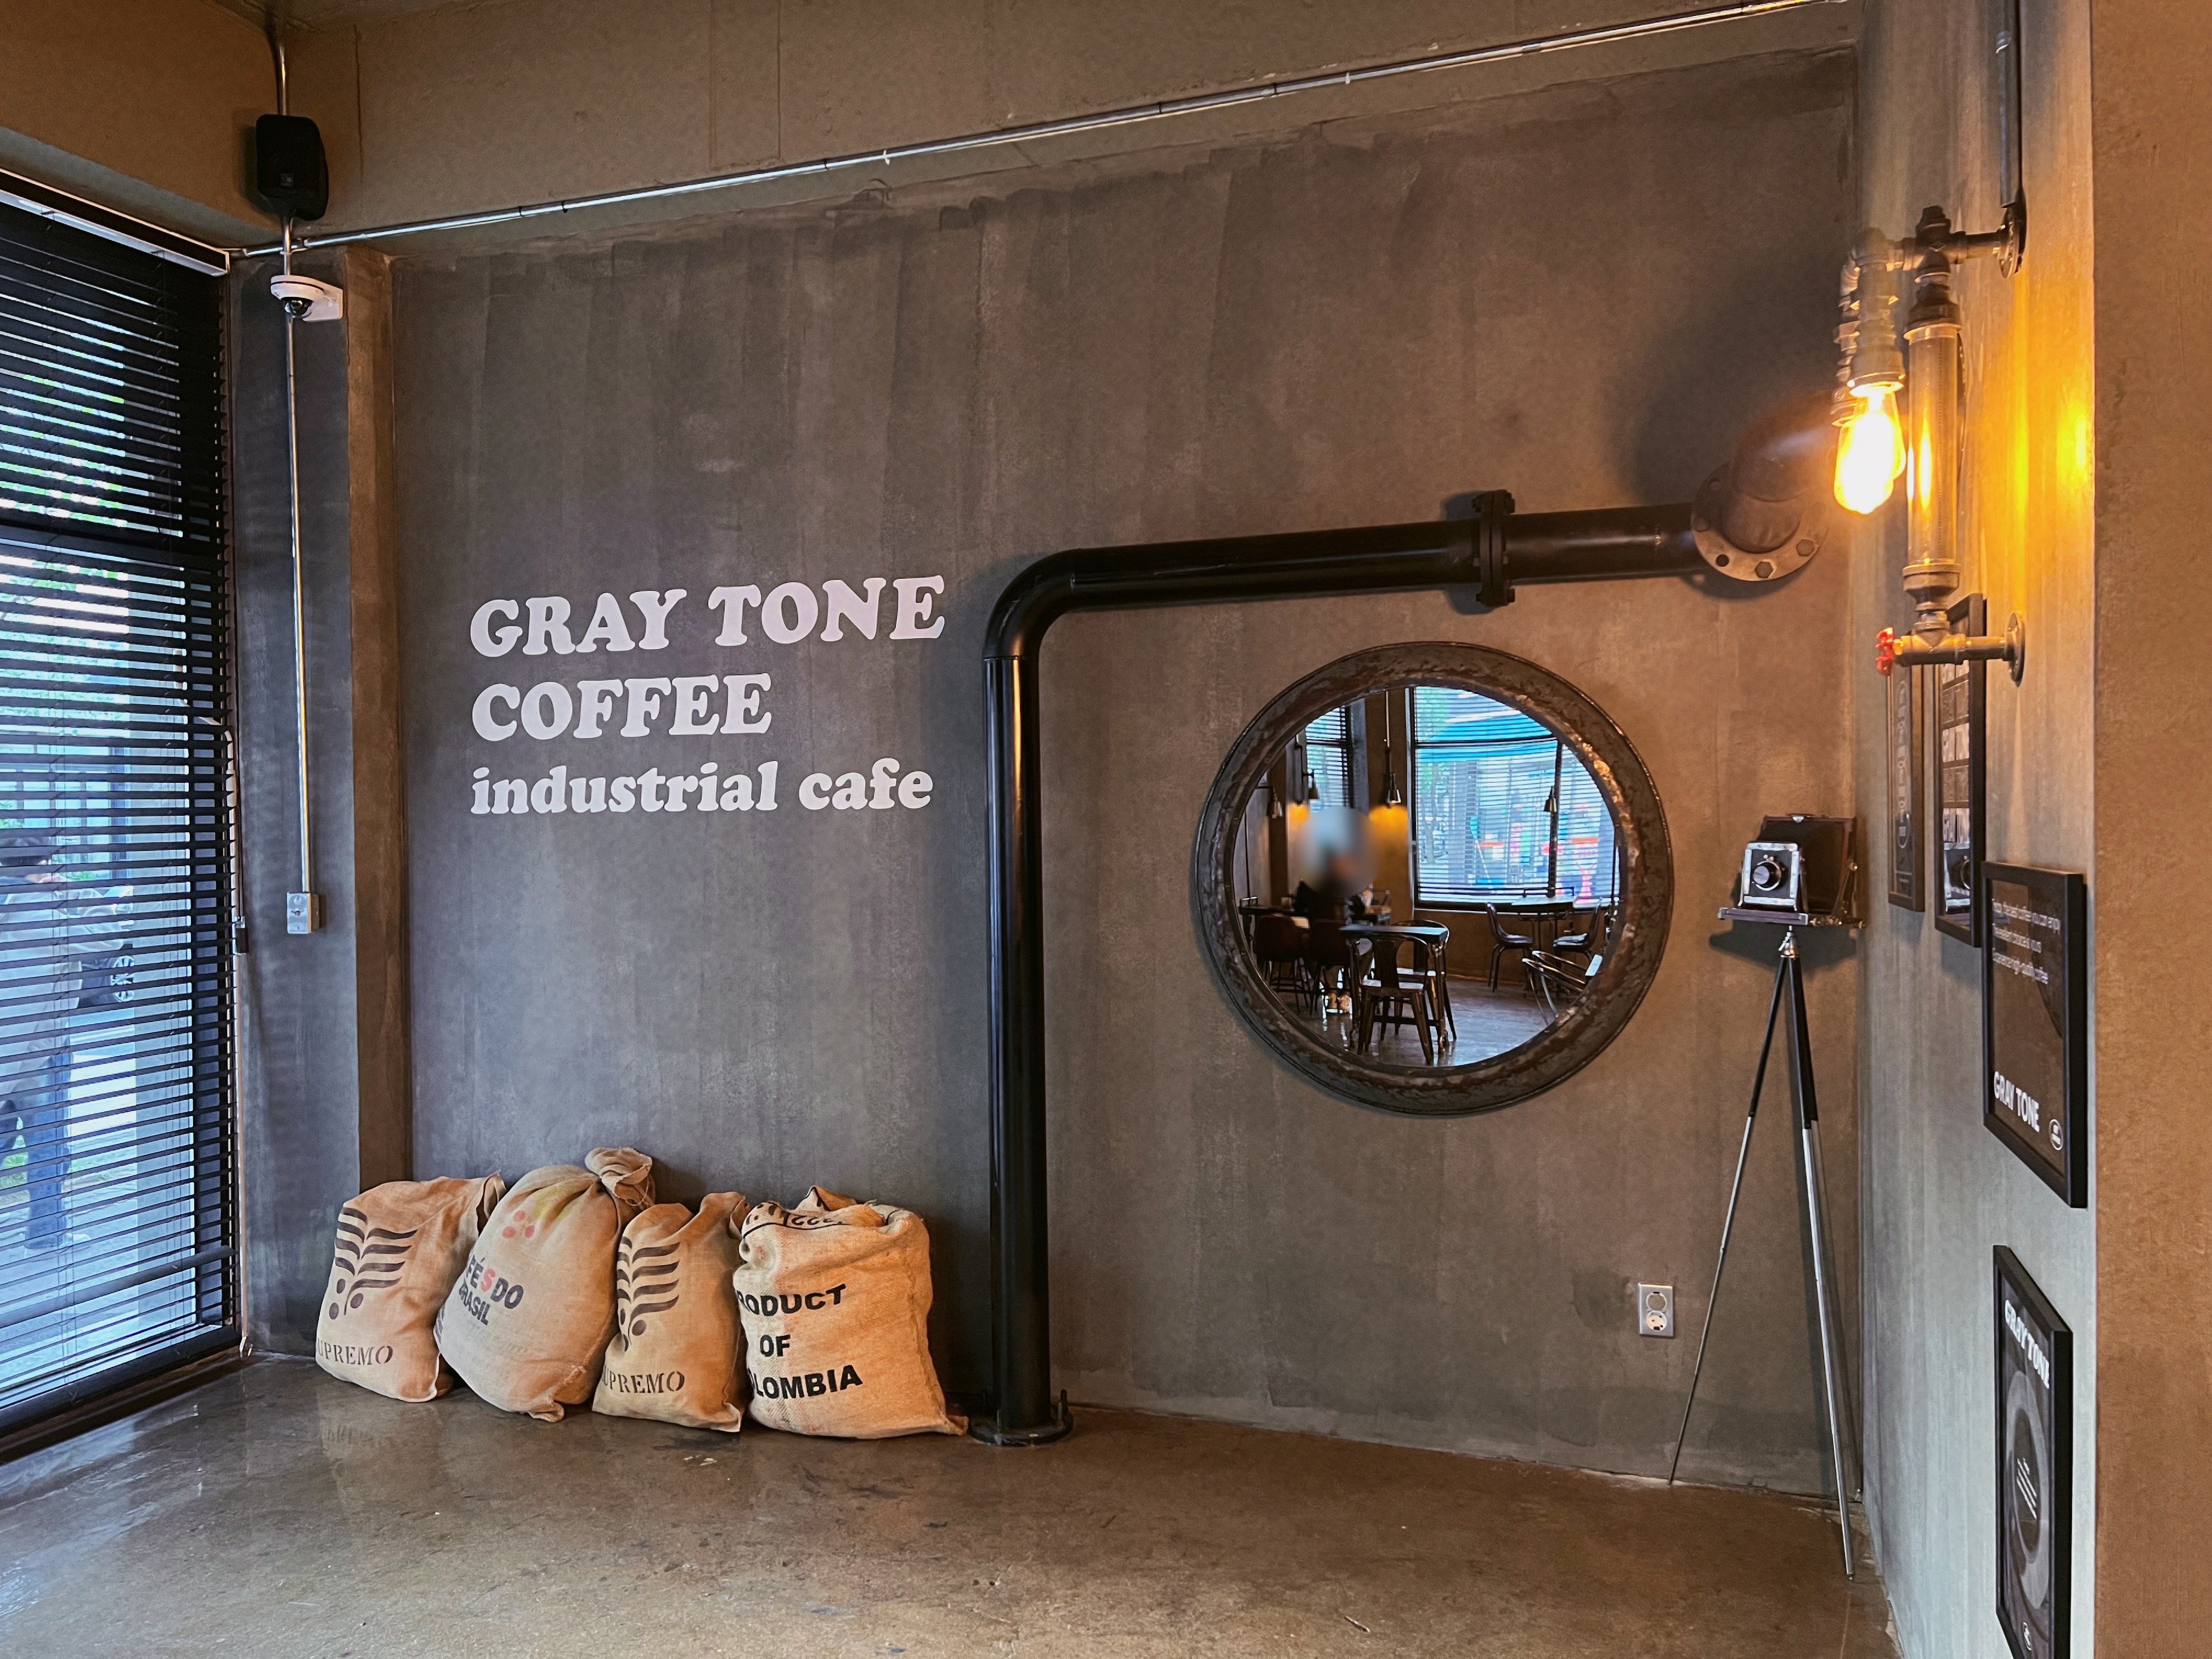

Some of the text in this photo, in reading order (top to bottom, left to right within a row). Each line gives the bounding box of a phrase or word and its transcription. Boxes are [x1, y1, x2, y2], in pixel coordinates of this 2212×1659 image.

[470, 575, 945, 657] GRAY TONE
[472, 673, 772, 742] COFFEE
[470, 758, 934, 814] industrial cafe
[1994, 1071, 2040, 1132] GRAY TONE
[466, 1254, 524, 1309] FÉS DO
[736, 1283, 847, 1317] RODUCT
[760, 1334, 791, 1357] OF
[2005, 1299, 2027, 1350] GRAY
[317, 1338, 393, 1365] UPREMO
[602, 1364, 685, 1393] UPREMO
[748, 1364, 864, 1400] LOMBIA
